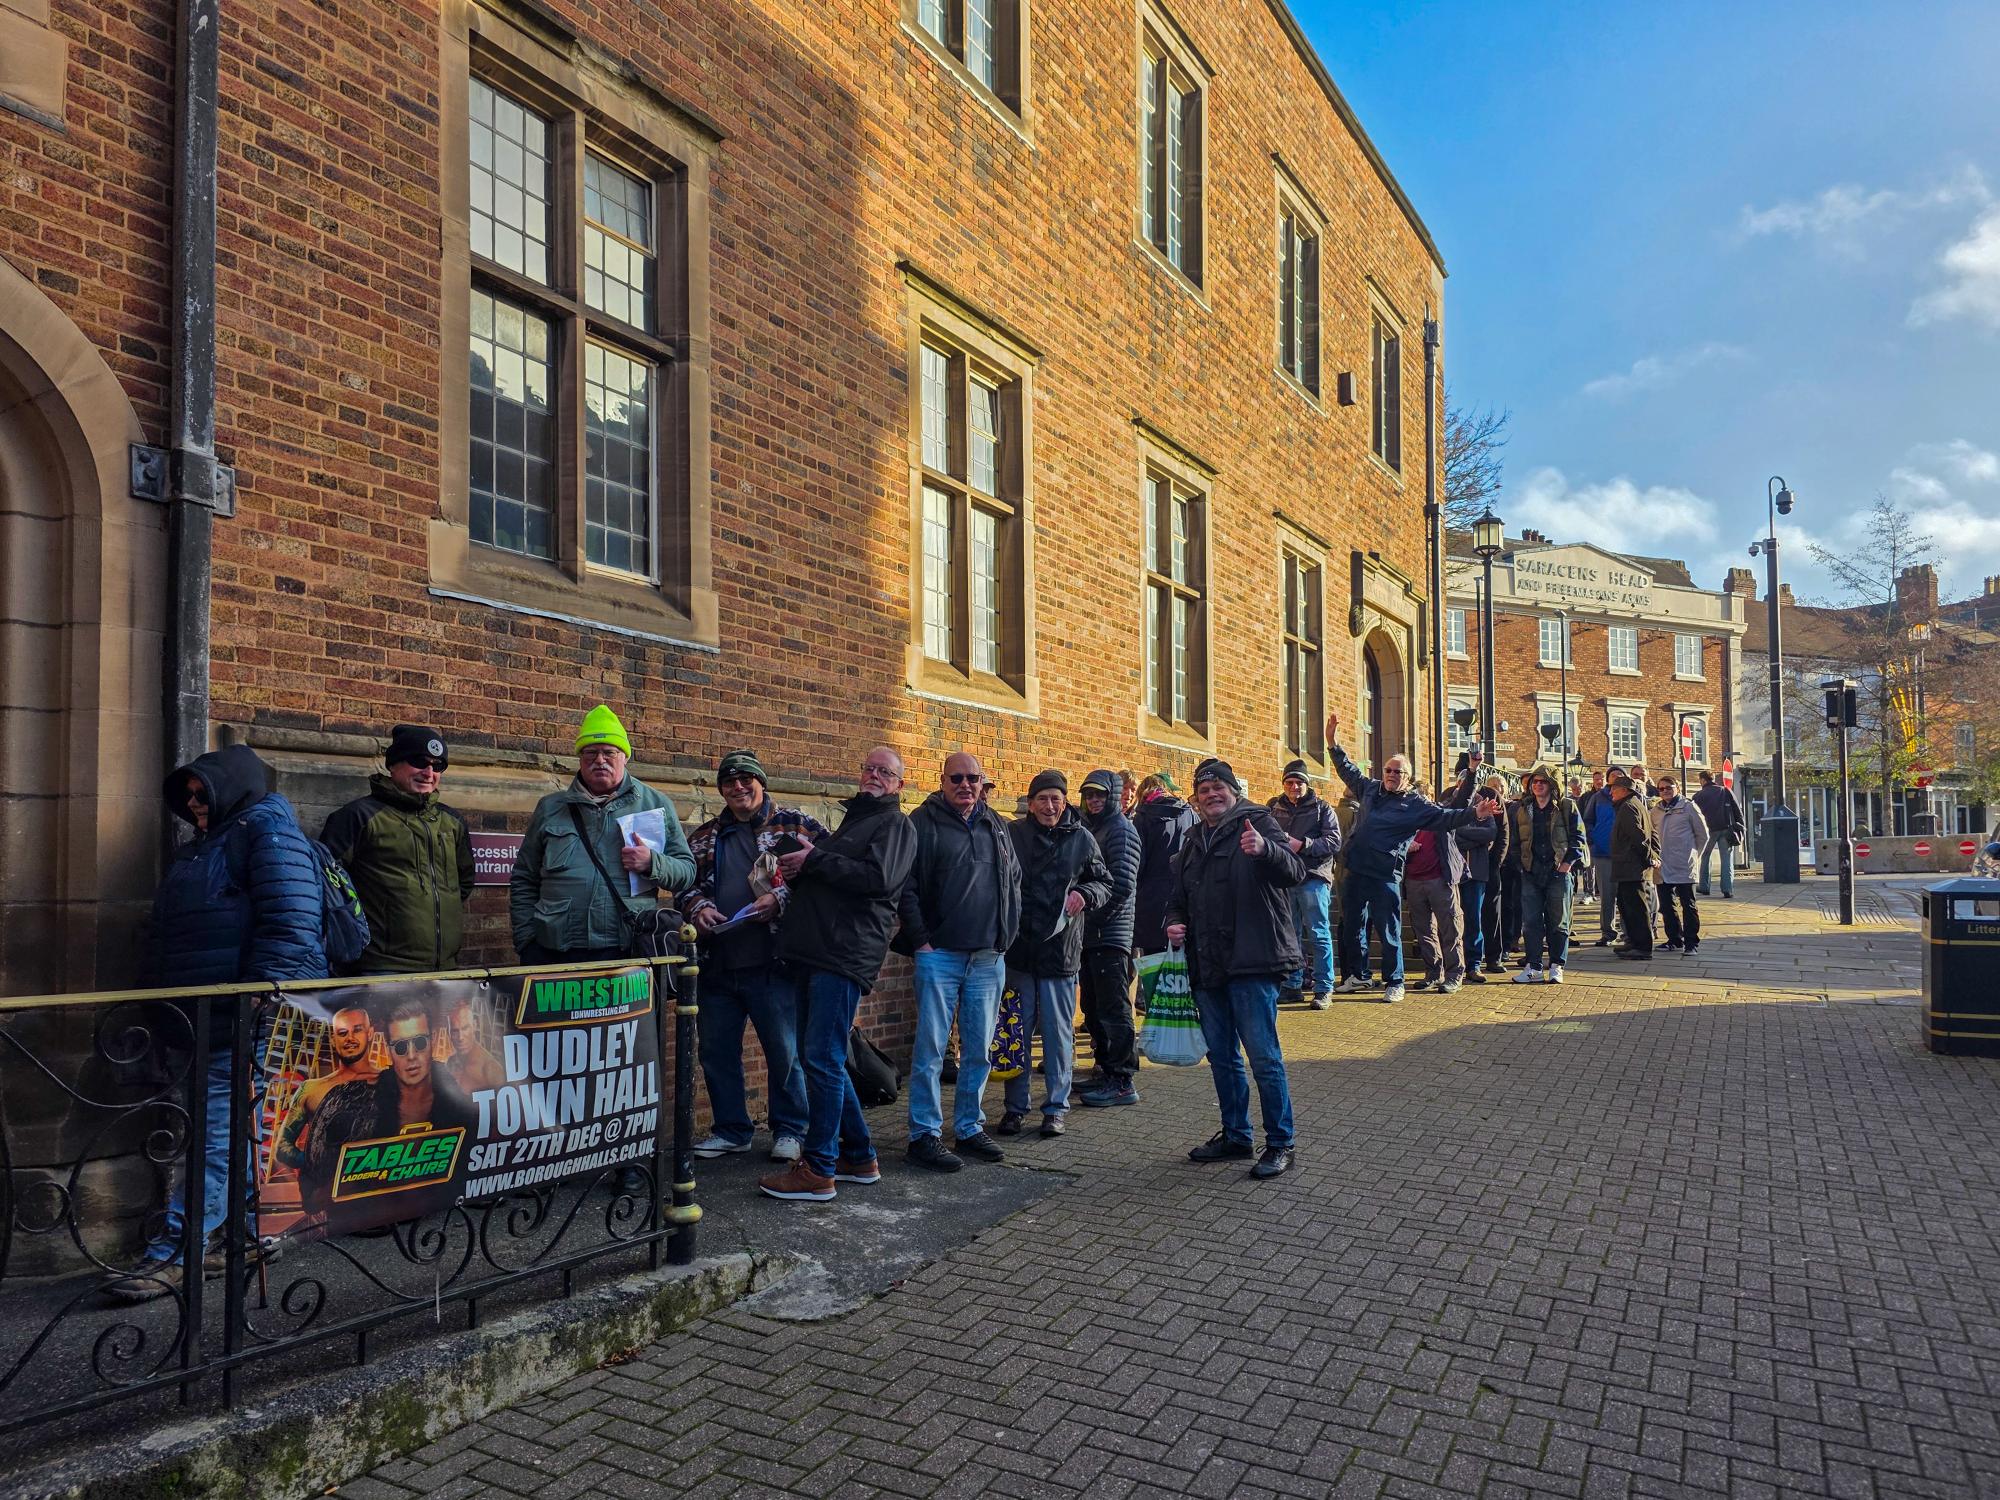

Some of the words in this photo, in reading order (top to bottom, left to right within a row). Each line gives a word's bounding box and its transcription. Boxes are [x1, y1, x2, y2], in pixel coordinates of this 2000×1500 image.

[1516, 558, 1598, 581] SARACENS
[1609, 571, 1649, 588] HEAD
[1517, 578, 1542, 591] AND
[1622, 593, 1650, 606] ARMS
[1967, 924, 2000, 934] Litter
[535, 971, 649, 1012] WRESTLING
[571, 1005, 629, 1020] LDNWRESTLING.COM
[503, 1020, 638, 1082] DUDLEY
[472, 1077, 586, 1139] TOWN
[593, 1061, 659, 1118] HALL
[344, 1135, 458, 1174] TABLES
[468, 1141, 510, 1172] SAT
[512, 1131, 564, 1164] 27TH
[566, 1122, 601, 1153] DEC
[604, 1117, 622, 1142] @
[624, 1108, 657, 1138] 7PM
[341, 1170, 380, 1183] LADDERS
[379, 1169, 389, 1180] &
[387, 1159, 449, 1182] CHAIRS
[465, 1137, 656, 1199] WWW.BOROUGHHALLS.CO.UK
